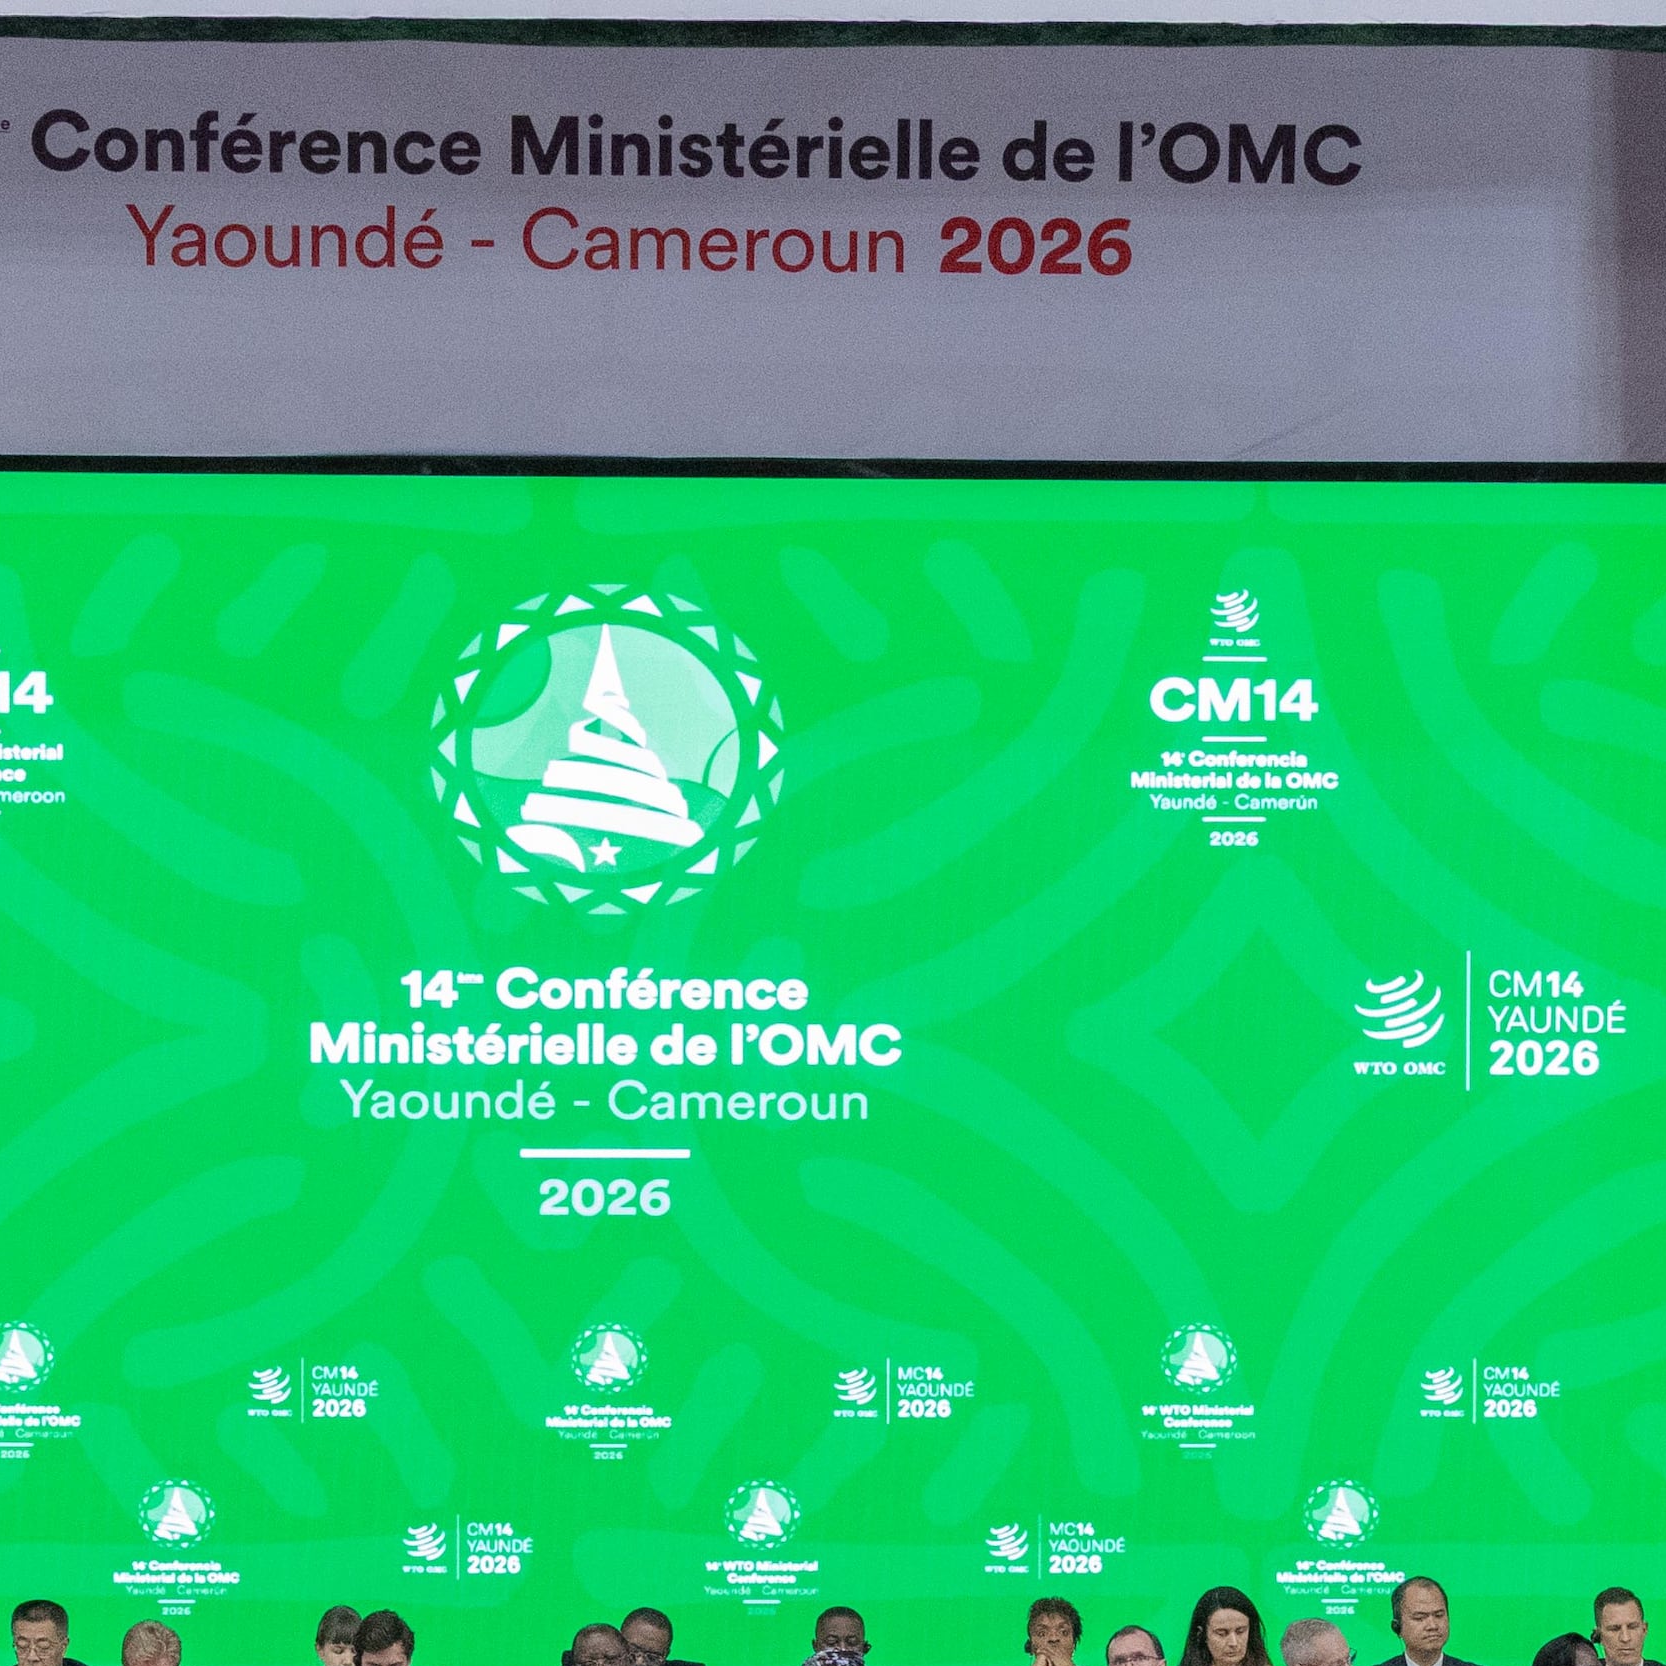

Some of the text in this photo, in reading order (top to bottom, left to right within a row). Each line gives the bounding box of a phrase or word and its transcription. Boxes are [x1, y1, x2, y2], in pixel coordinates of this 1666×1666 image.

[32, 109, 481, 175] Conférence
[512, 114, 980, 180] Ministérielle
[1003, 121, 1094, 182] de
[1119, 122, 1361, 185] l'OMC
[127, 204, 1131, 275] Yaoundé Cameroun 2026
[1150, 677, 1318, 721] CM14
[1189, 751, 1307, 767] Conferencia
[1130, 772, 1338, 788] Ministerial de la OMC
[1150, 794, 1318, 810] Yaundé Camerún
[1211, 832, 1258, 846] 2026
[497, 967, 808, 1010] Conférence
[1490, 970, 1583, 997] CM14
[1489, 1000, 1625, 1033] YAUNDÉ
[311, 1022, 901, 1066] Ministérielle de l'OMC
[1490, 1040, 1599, 1075] 2026
[1354, 1062, 1444, 1074] WTO OMC
[341, 1080, 867, 1120] Yaoundé Cameroun
[540, 1179, 670, 1216] 2026
[898, 1367, 943, 1380] MC14
[897, 1381, 973, 1400] YAOUNDÉ
[898, 1400, 951, 1417] 2026
[1484, 1399, 1537, 1417] 2026
